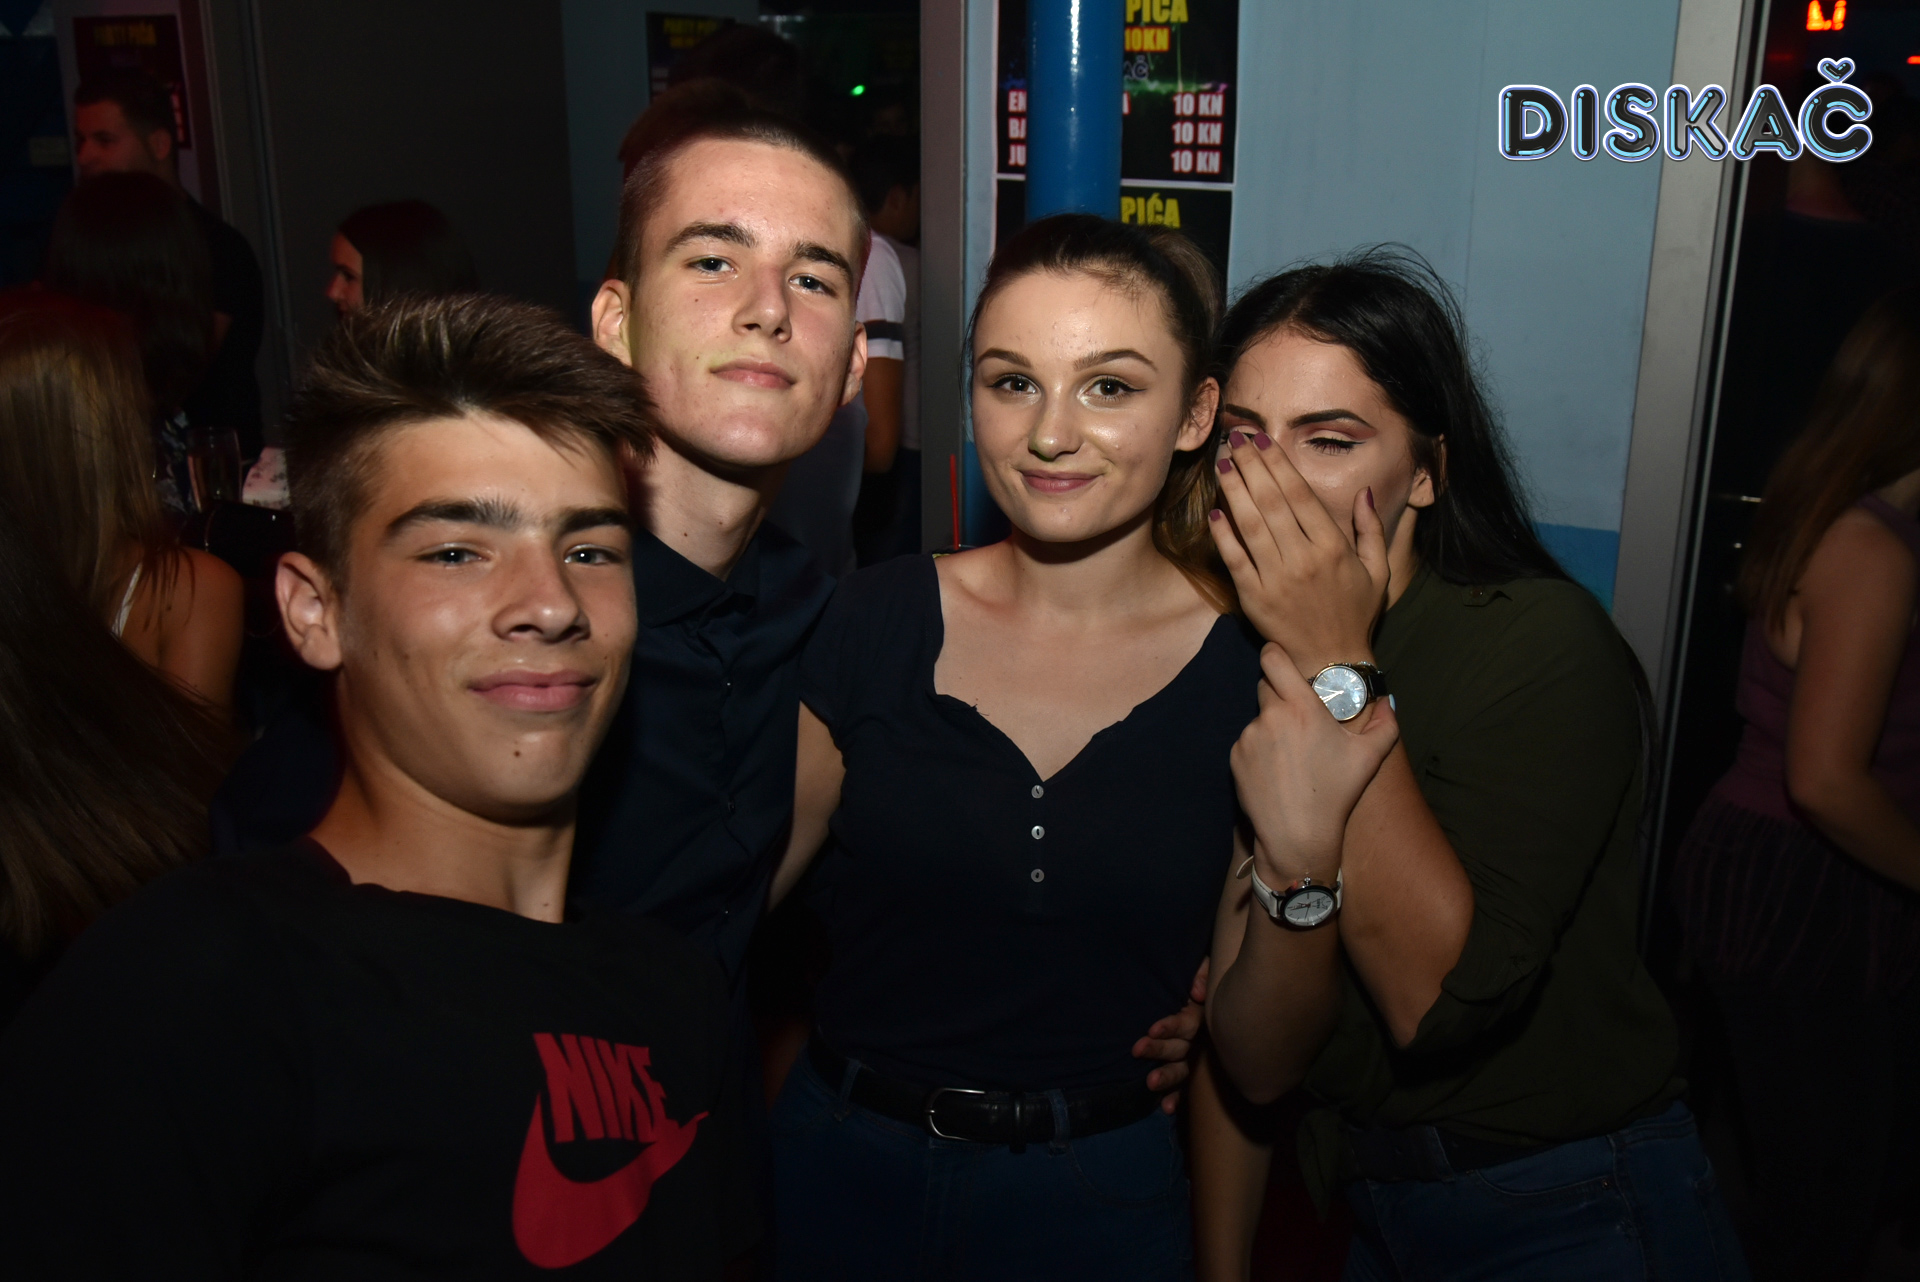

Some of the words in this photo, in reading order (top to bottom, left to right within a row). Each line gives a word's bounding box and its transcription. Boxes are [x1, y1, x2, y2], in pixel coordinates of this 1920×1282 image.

[1172, 92, 1195, 116] 10
[1197, 92, 1224, 117] KN
[1171, 121, 1194, 145] 10
[1196, 121, 1223, 146] KN
[1170, 150, 1194, 173] 10
[1195, 150, 1222, 174] KN
[532, 1031, 680, 1144] NIKE
